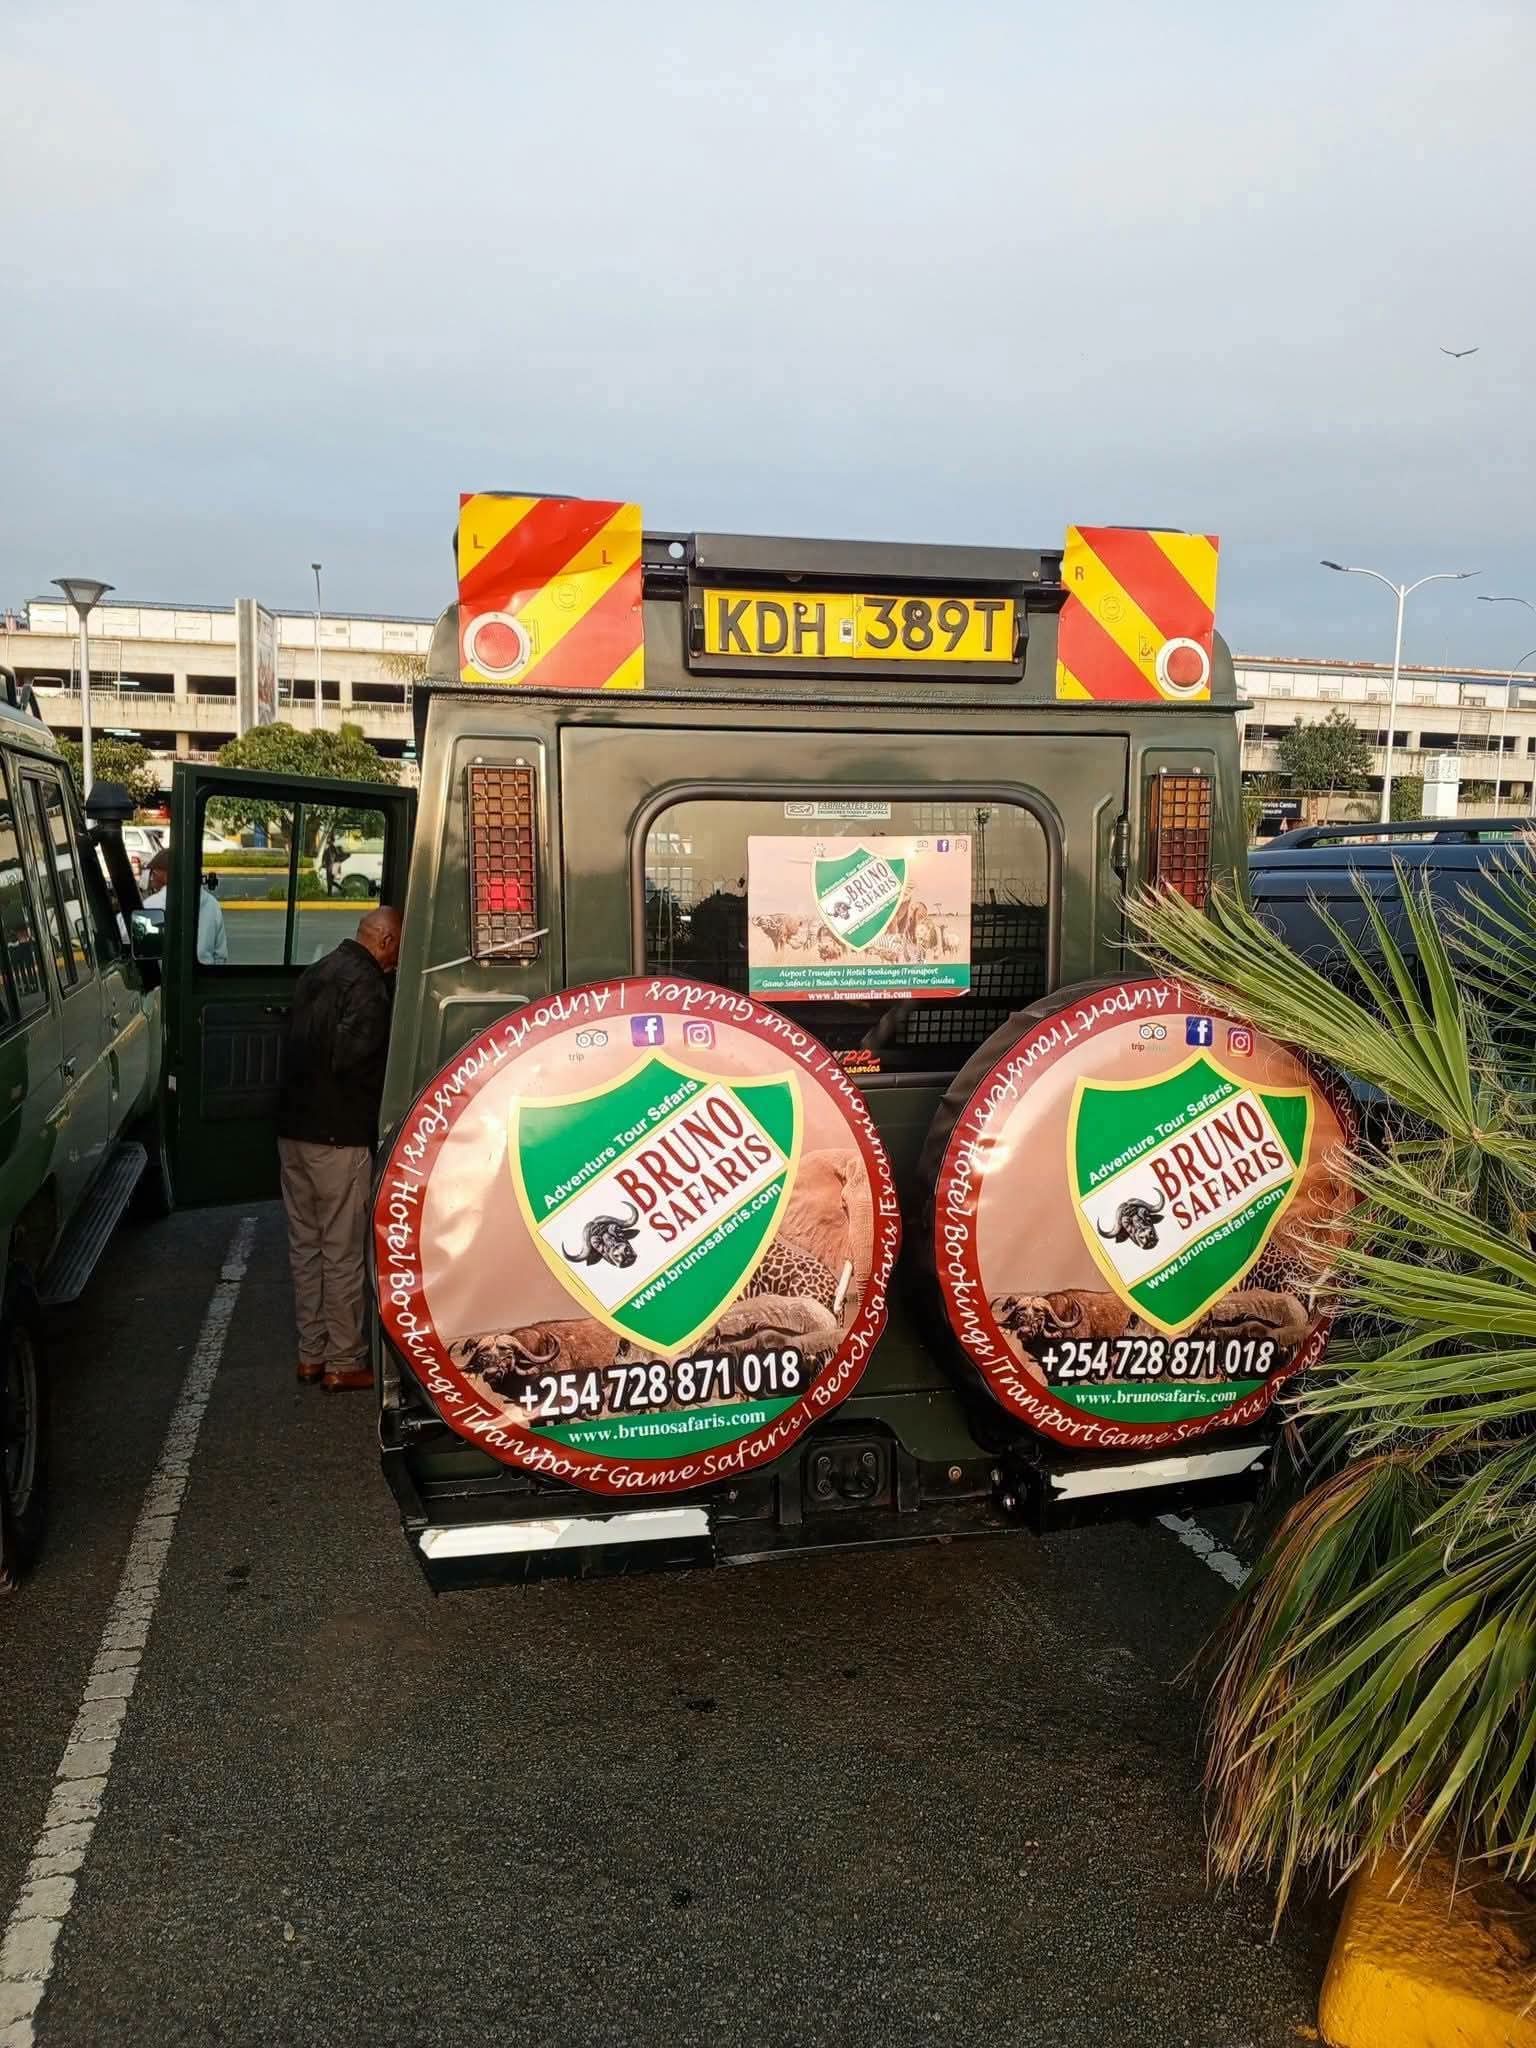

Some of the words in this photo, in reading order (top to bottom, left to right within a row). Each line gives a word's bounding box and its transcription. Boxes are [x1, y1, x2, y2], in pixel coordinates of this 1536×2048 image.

[473, 534, 485, 549] L
[602, 550, 613, 565] L
[1075, 566, 1085, 581] R
[717, 597, 826, 656] KDH
[863, 597, 1005, 652] 389T
[844, 862, 889, 902] BRUNO
[854, 878, 897, 912] SAFARIS
[646, 980, 754, 1022] Guides
[779, 969, 806, 979] Airport
[847, 968, 866, 976] Hotel
[867, 967, 900, 978] Bookings
[807, 989, 912, 1000] www.brunosafaris.com
[912, 977, 929, 985] Tour
[930, 976, 955, 985] Guides
[505, 986, 611, 1048] Airport
[755, 1014, 818, 1064] Tour
[1076, 986, 1171, 1031] Airport
[403, 1038, 508, 1164] Transfers
[974, 1019, 1080, 1123] Transfers
[542, 1145, 617, 1209] Adventure
[613, 1118, 648, 1150] Tour
[647, 1080, 698, 1123] Safaris
[613, 1096, 744, 1215] BRUNO
[1088, 1134, 1156, 1186] Adventure
[1154, 1114, 1186, 1138] Tour
[1186, 1082, 1234, 1117] Safaris
[1149, 1101, 1264, 1202] BRUNO
[649, 1133, 772, 1242] SAFARIS
[945, 1138, 985, 1224] Hotel
[1171, 1140, 1285, 1231] SAFARIS
[386, 1180, 419, 1267] Hotel
[631, 1182, 783, 1311] www.brunosafaris.com
[1146, 1187, 1285, 1289] www.brunosafaris.com
[866, 1220, 899, 1324] Safaris
[943, 1223, 996, 1358] Bookings
[389, 1267, 464, 1405] Bookings
[812, 1324, 875, 1407] Beach
[1042, 1341, 1109, 1379] +254
[1115, 1340, 1165, 1375] 728
[1170, 1339, 1216, 1375] 871
[1225, 1339, 1274, 1374] 018
[519, 1371, 601, 1418] +254
[607, 1364, 668, 1407] 728
[676, 1357, 731, 1402] 871
[742, 1351, 800, 1393] 018
[1076, 1389, 1237, 1405] www.brunosafaris.com
[568, 1411, 767, 1443] www.brunosafaris.com
[703, 1415, 801, 1478] Safaris
[1099, 1426, 1174, 1447] Game
[609, 1463, 701, 1489] Game
